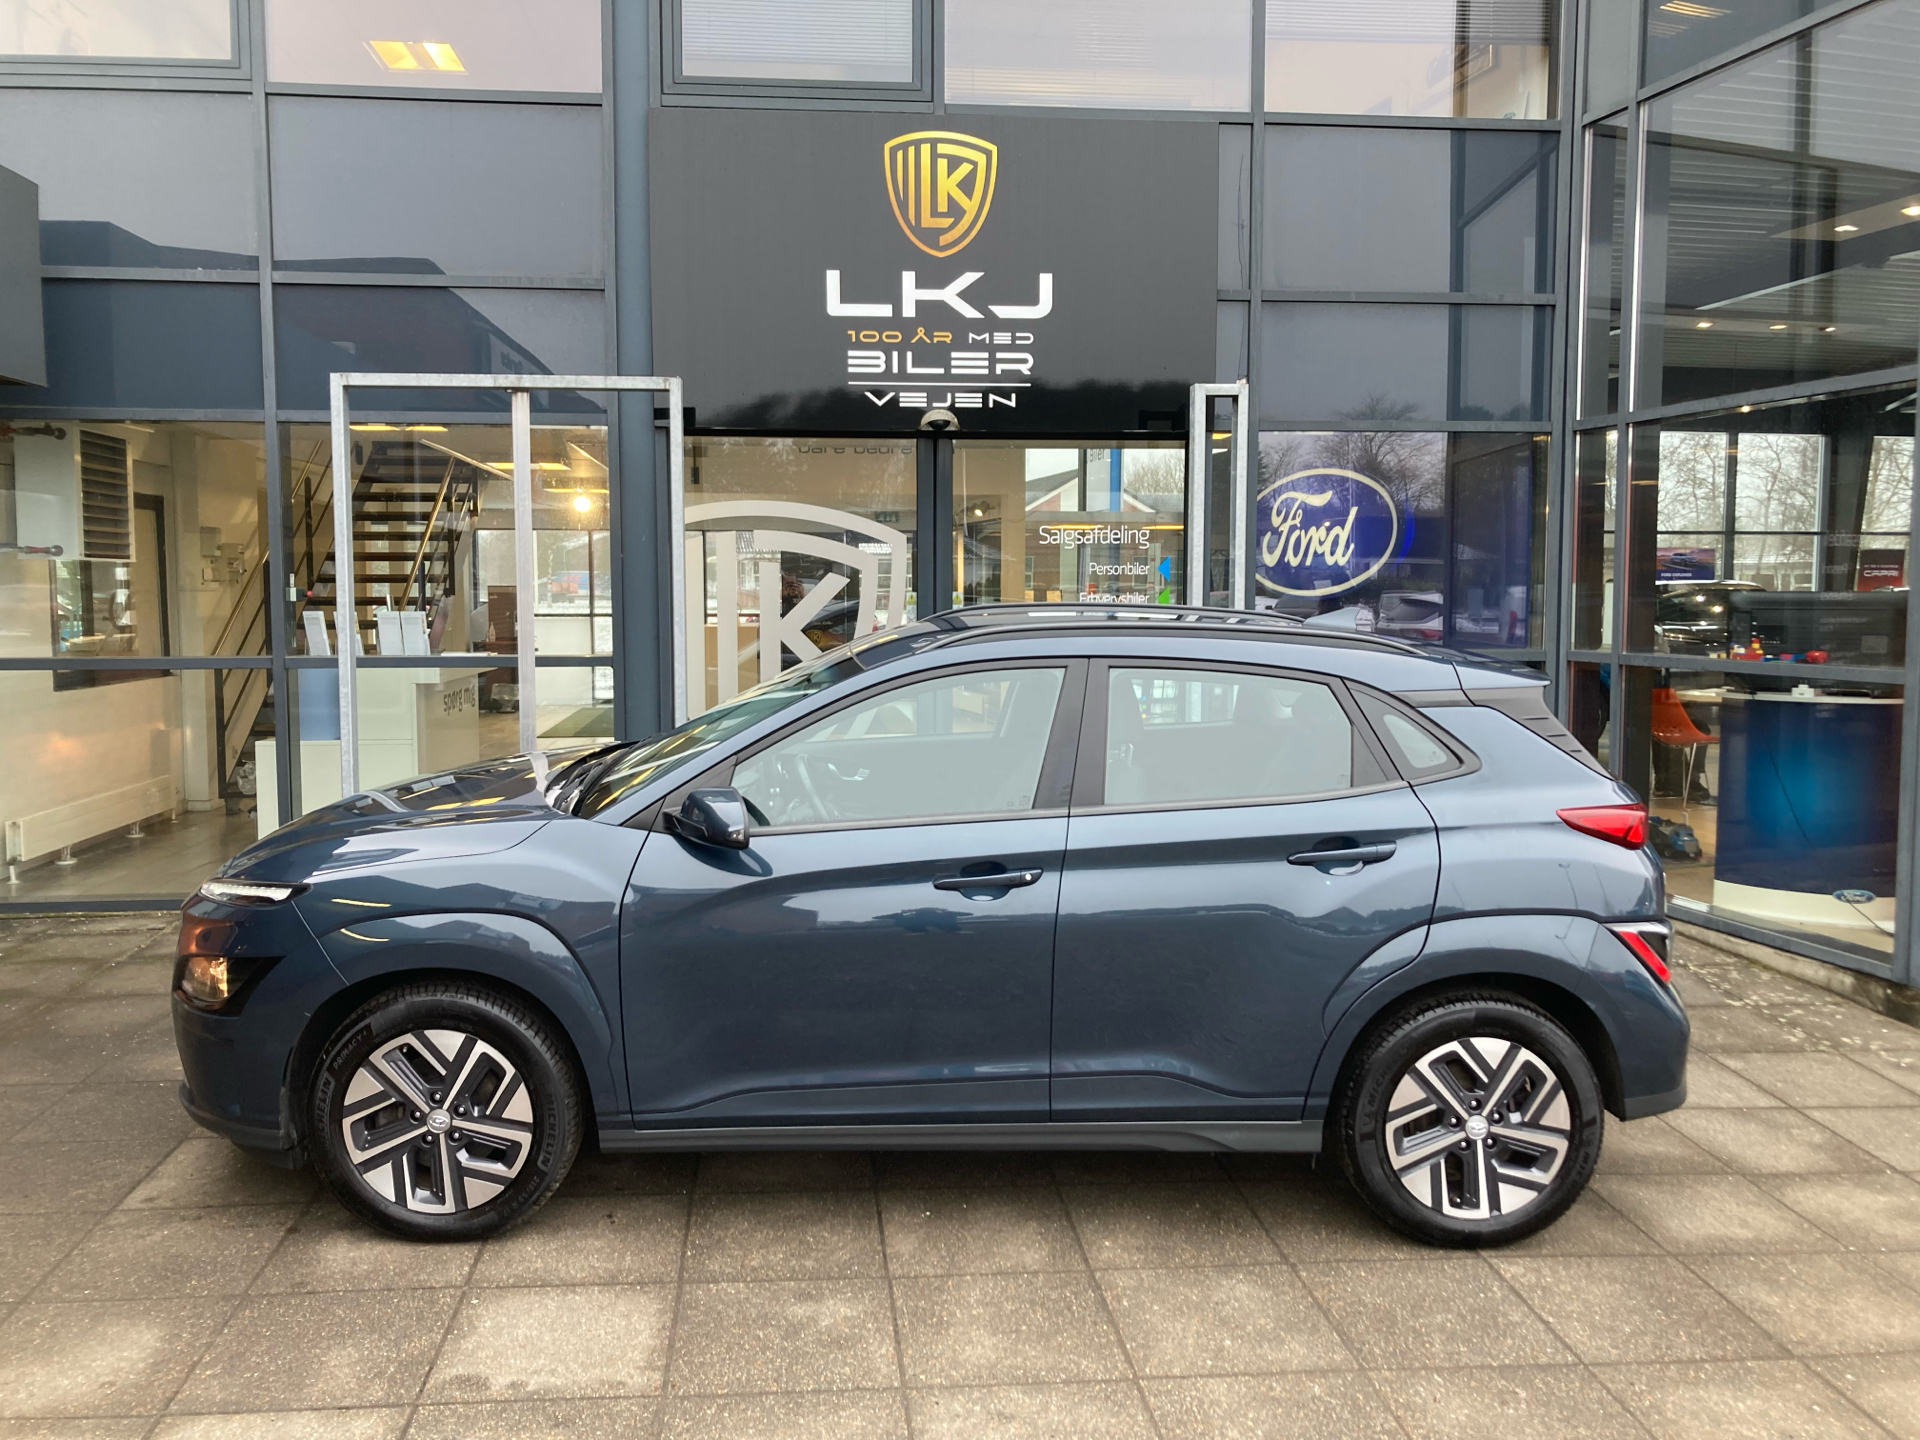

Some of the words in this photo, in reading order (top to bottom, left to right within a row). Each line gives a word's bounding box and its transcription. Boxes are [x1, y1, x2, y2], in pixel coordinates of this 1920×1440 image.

[826, 269, 1053, 319] LKJ
[847, 330, 902, 343] 100
[910, 327, 953, 343] ÅR
[968, 332, 1034, 344] MED
[847, 350, 1034, 375] BILER
[864, 391, 1016, 408] VEJEN
[1039, 525, 1150, 549] Salgsafdeling
[1262, 490, 1358, 567] Ford
[1089, 562, 1150, 575] Personbiler
[1863, 569, 1899, 577] CAPRI
